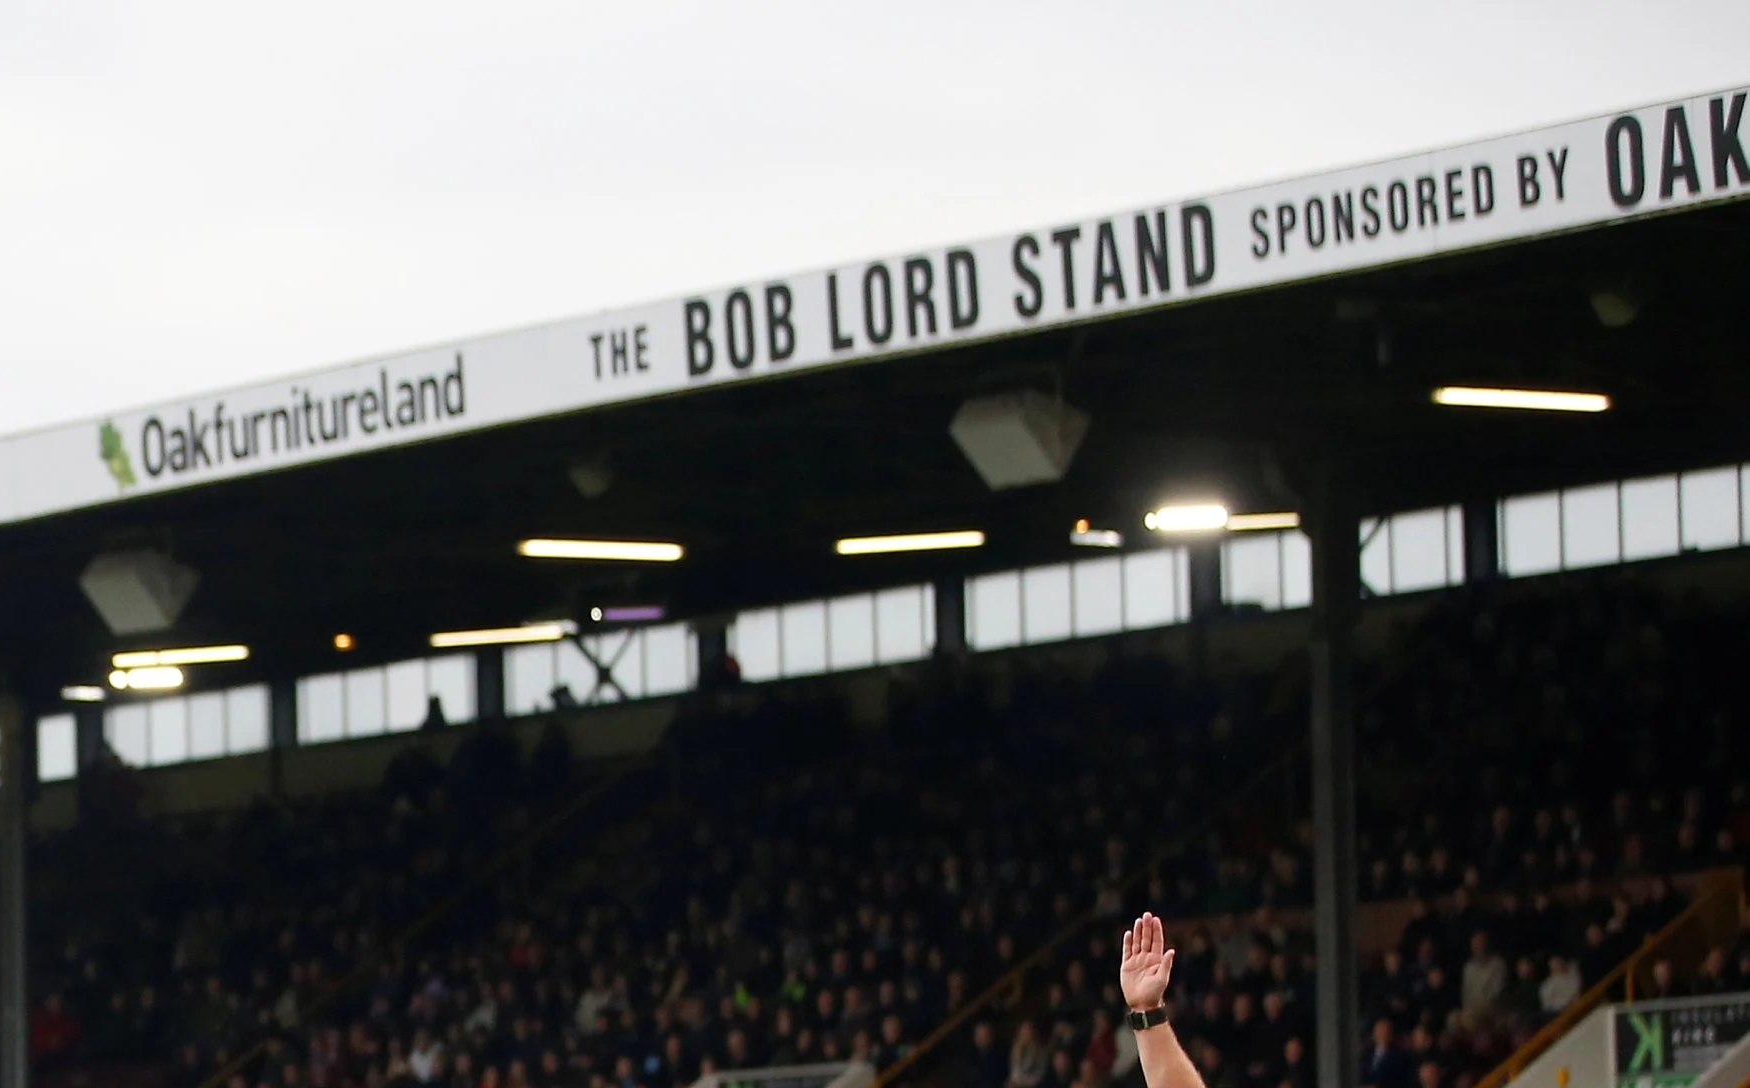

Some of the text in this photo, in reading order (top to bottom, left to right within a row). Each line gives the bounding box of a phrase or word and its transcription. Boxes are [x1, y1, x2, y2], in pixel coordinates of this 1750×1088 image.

[589, 90, 1750, 381] THE BOB LORD STAND SPONSORED BY OAK
[142, 353, 467, 479] Oakfurnitureland
